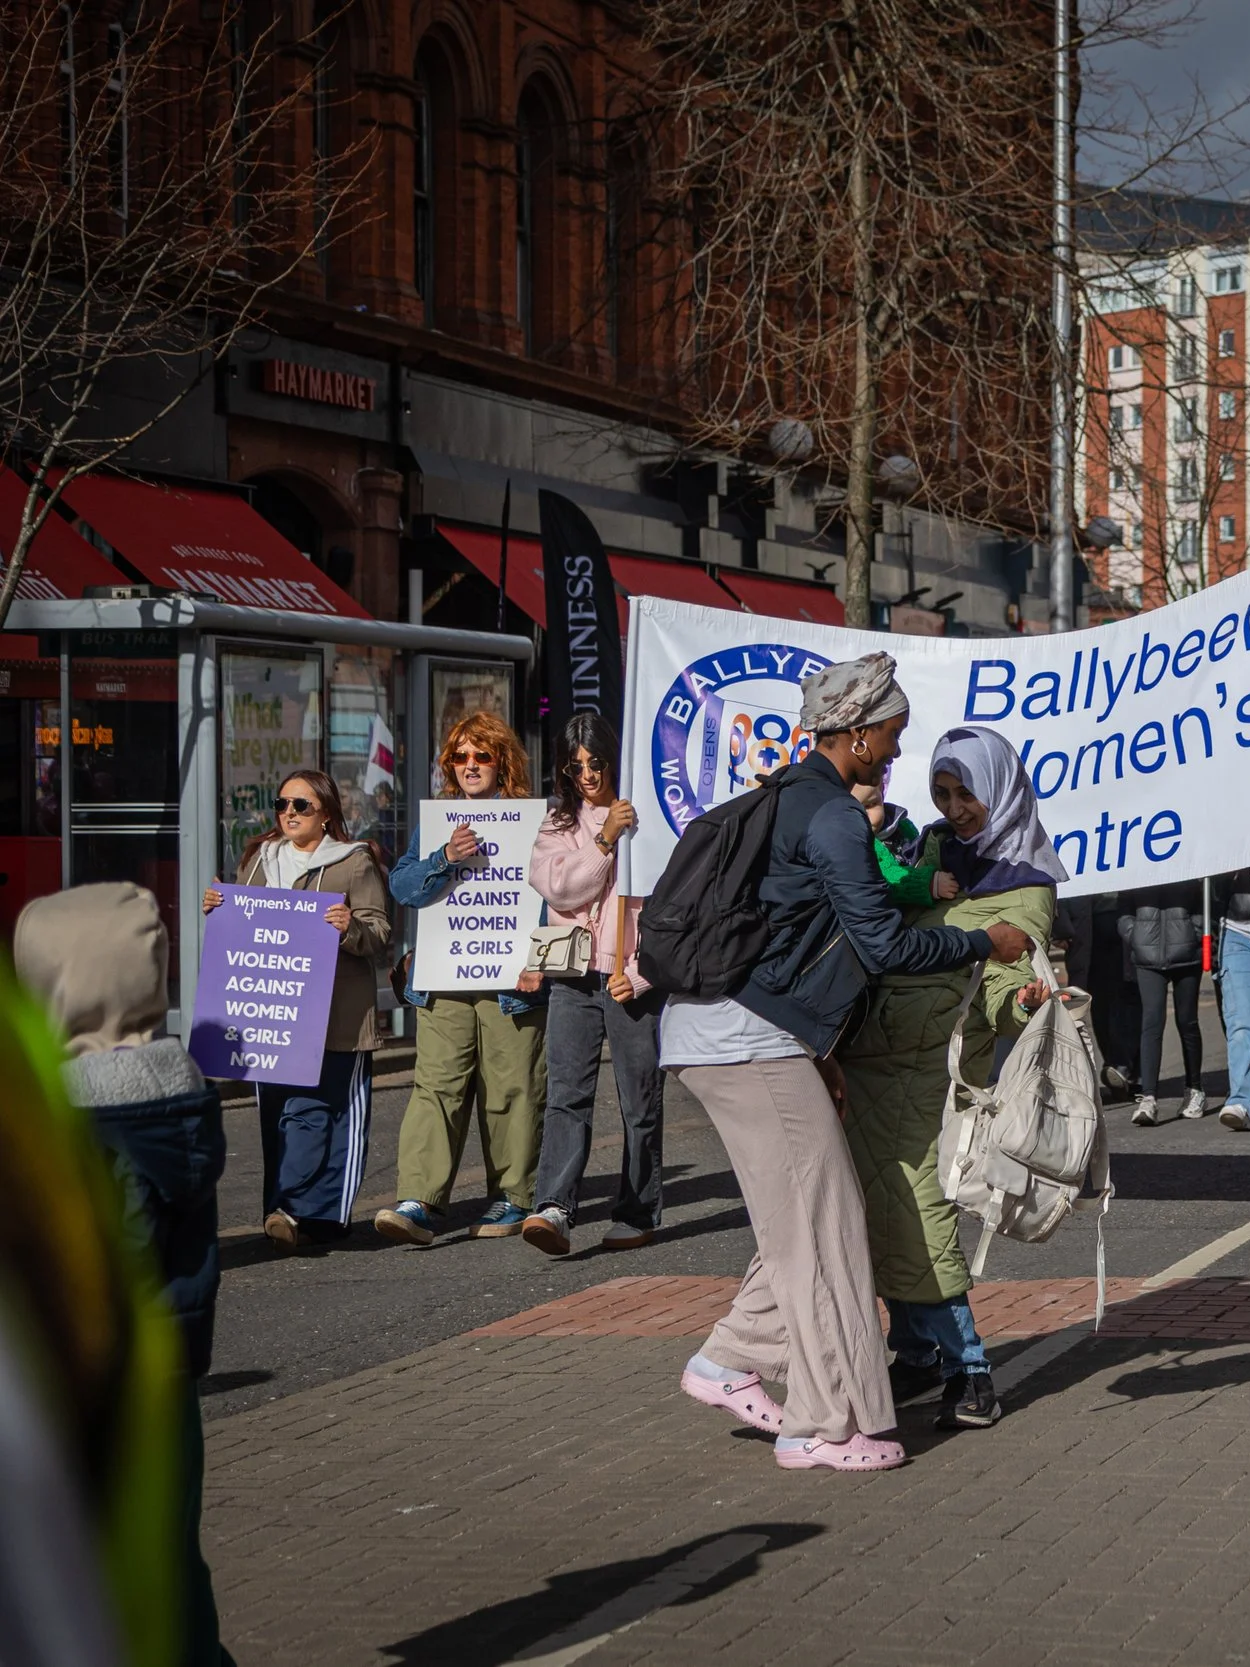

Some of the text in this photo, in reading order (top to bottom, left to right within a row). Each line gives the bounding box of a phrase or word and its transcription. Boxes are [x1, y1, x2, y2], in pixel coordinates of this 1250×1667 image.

[274, 358, 377, 412] HAYMARKET
[160, 566, 337, 613] HAYMARKET
[81, 632, 171, 645] BUS TRAK
[564, 555, 601, 716] INNESS
[231, 739, 303, 774] are you
[703, 717, 716, 787] OPENS
[446, 812, 521, 828] Women's Aid
[469, 842, 499, 857] ND
[1053, 809, 1183, 876] ntre
[452, 867, 524, 881] IOLENCE
[234, 894, 317, 920] Women's Aid
[446, 892, 520, 906] AGAINST
[448, 916, 517, 931] WOMEN
[254, 928, 289, 945] END
[449, 941, 513, 955] & GIRLS
[226, 950, 311, 972] VIOLENCE
[456, 965, 502, 979] NOW
[225, 976, 305, 997] AGAINST
[226, 1001, 298, 1021] WOMEN
[224, 1026, 291, 1046] & GIRLS
[230, 1051, 279, 1070] NOW
